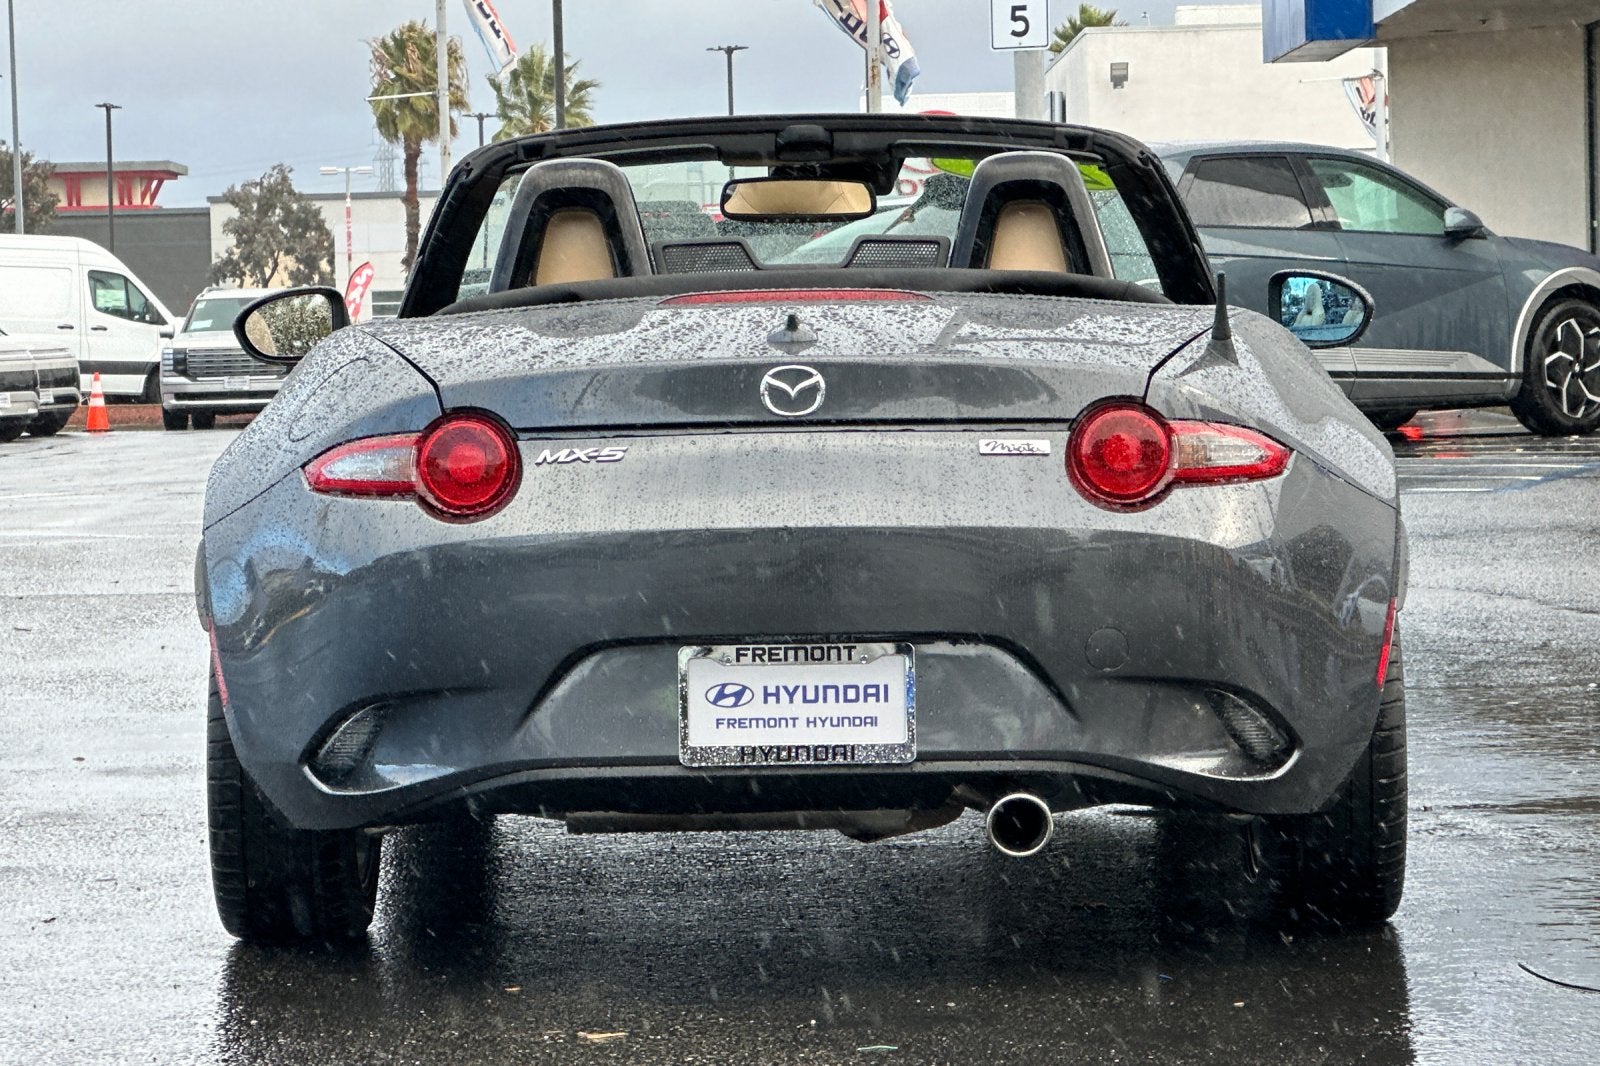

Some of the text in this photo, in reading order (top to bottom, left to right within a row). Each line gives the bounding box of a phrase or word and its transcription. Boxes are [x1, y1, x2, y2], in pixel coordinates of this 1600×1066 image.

[1010, 4, 1030, 38] 5
[534, 446, 629, 467] MX-5
[735, 645, 857, 663] FREMONT
[762, 684, 889, 705] HYUNDAI
[715, 716, 878, 729] FREMONT HYUNDAI
[740, 744, 856, 763] HYUNDAI
